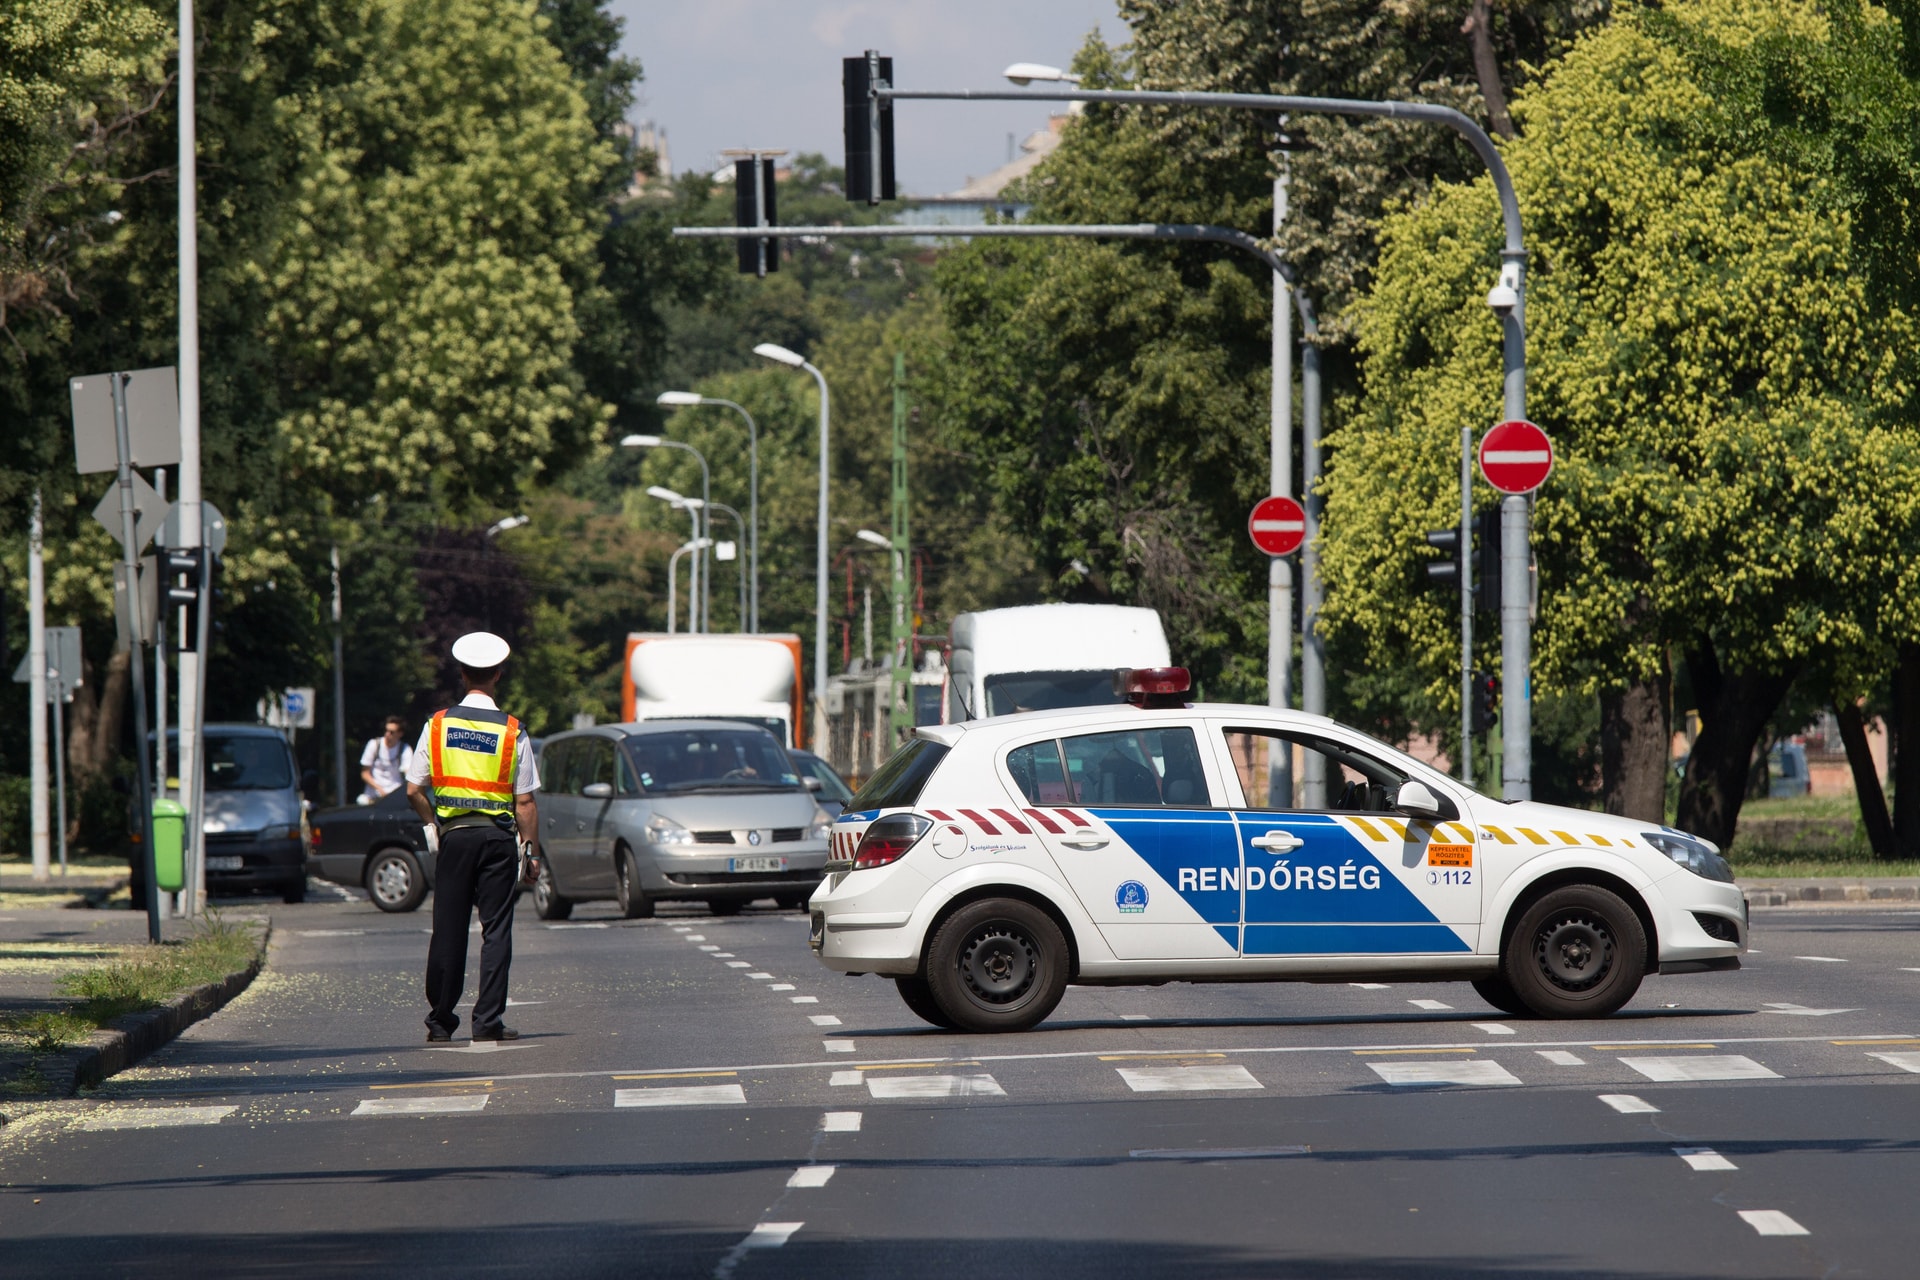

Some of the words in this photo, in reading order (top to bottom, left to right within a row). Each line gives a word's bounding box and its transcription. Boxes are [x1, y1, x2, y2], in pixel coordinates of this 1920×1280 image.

[460, 742, 480, 751] POLICE
[1179, 860, 1381, 891] RENDŐRSÉG
[1443, 870, 1471, 885] 112
